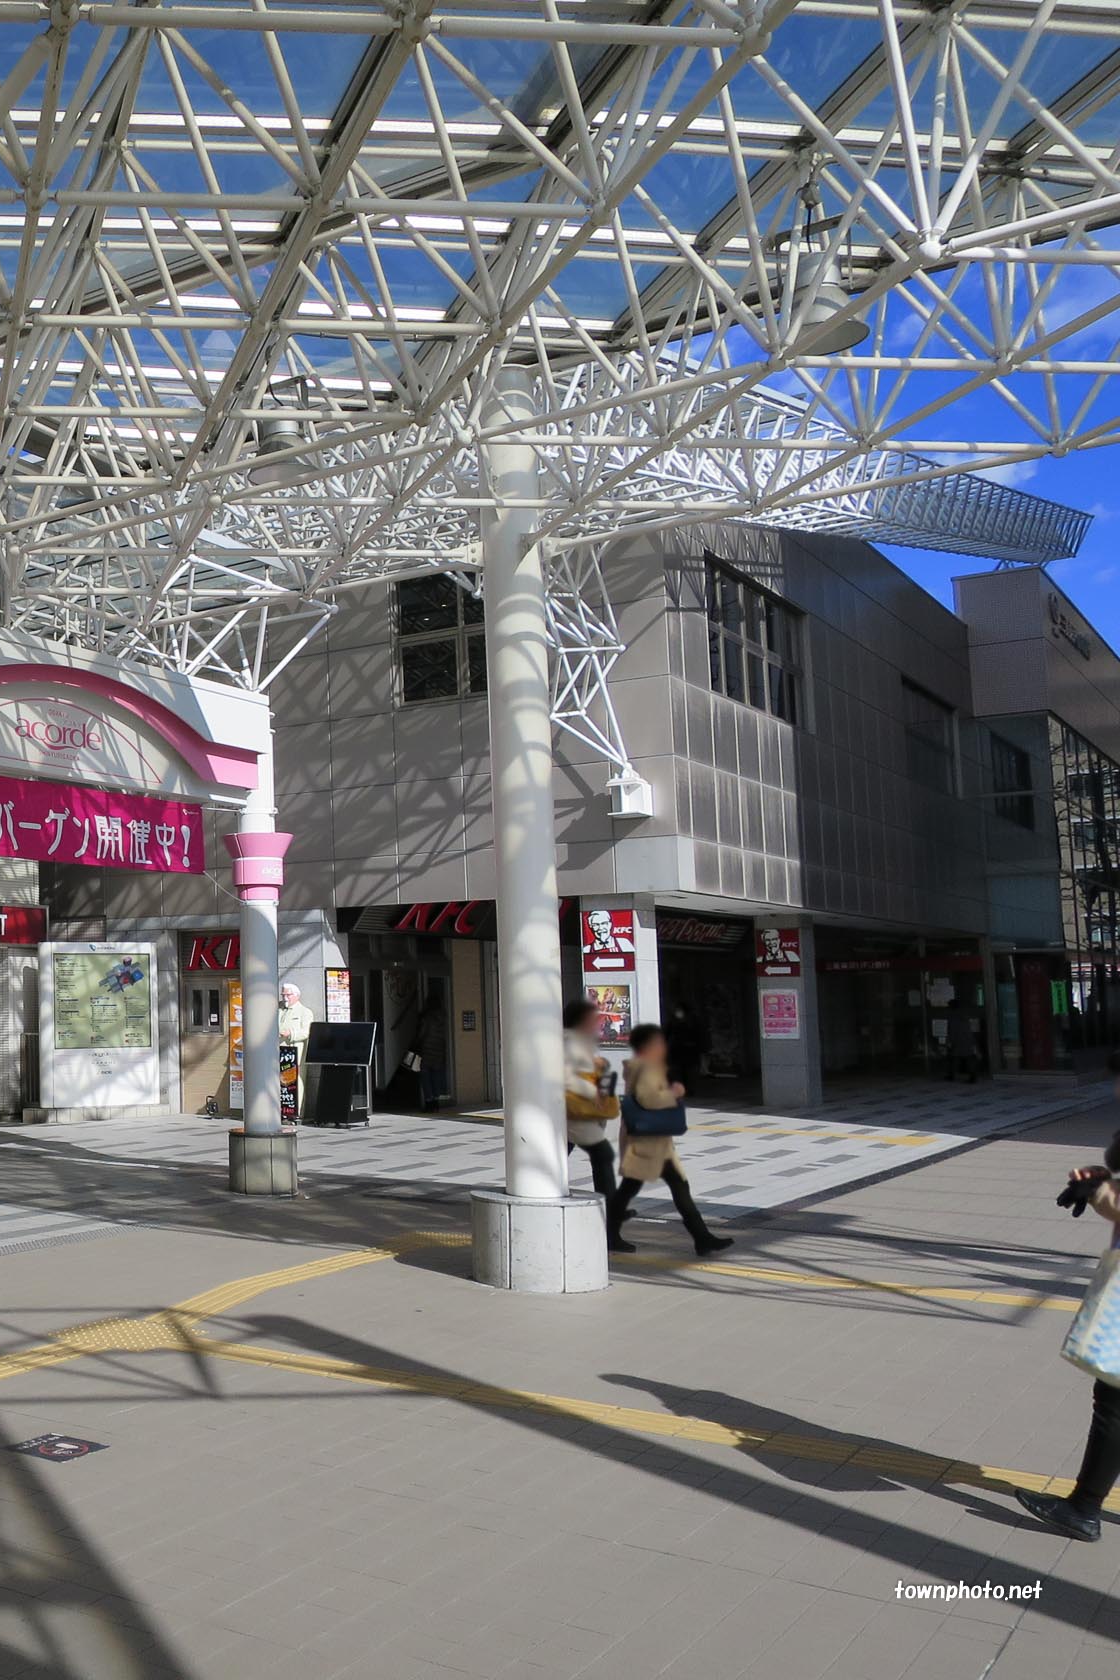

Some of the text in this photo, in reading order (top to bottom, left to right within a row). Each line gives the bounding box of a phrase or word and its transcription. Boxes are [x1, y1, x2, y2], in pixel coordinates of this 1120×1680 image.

[14, 717, 102, 751] acorde
[393, 901, 480, 935] KFC
[612, 926, 633, 935] KFC
[781, 941, 798, 949] KFC
